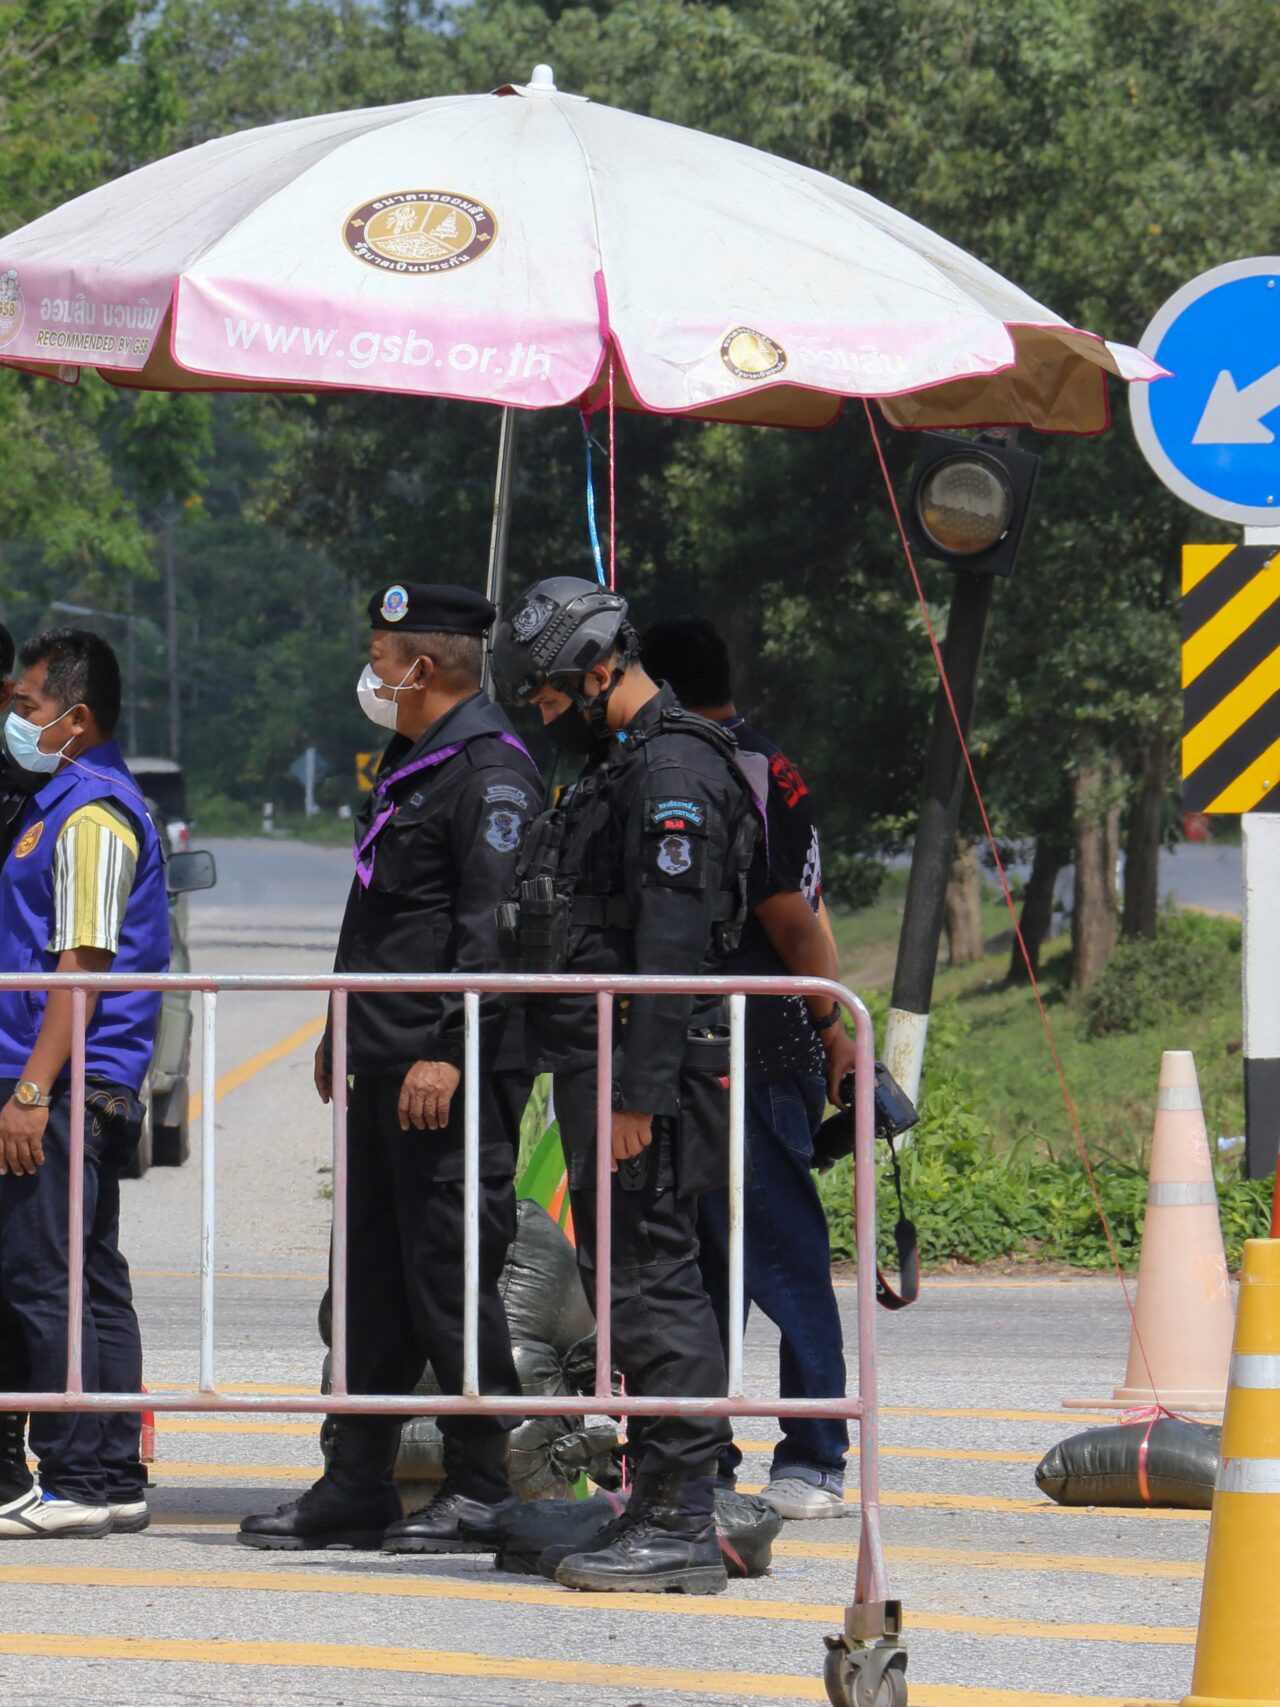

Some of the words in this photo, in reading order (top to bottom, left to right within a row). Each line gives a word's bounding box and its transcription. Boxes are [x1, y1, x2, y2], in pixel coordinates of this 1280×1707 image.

[372, 193, 487, 222] ธนาคารออมสิน
[353, 241, 471, 273] รัฐบาลเป็นประกัน
[36, 329, 116, 352] RECOMMENDED
[118, 336, 133, 353] BY
[132, 338, 150, 355] GSB
[224, 317, 552, 380] www.gsb.or.th
